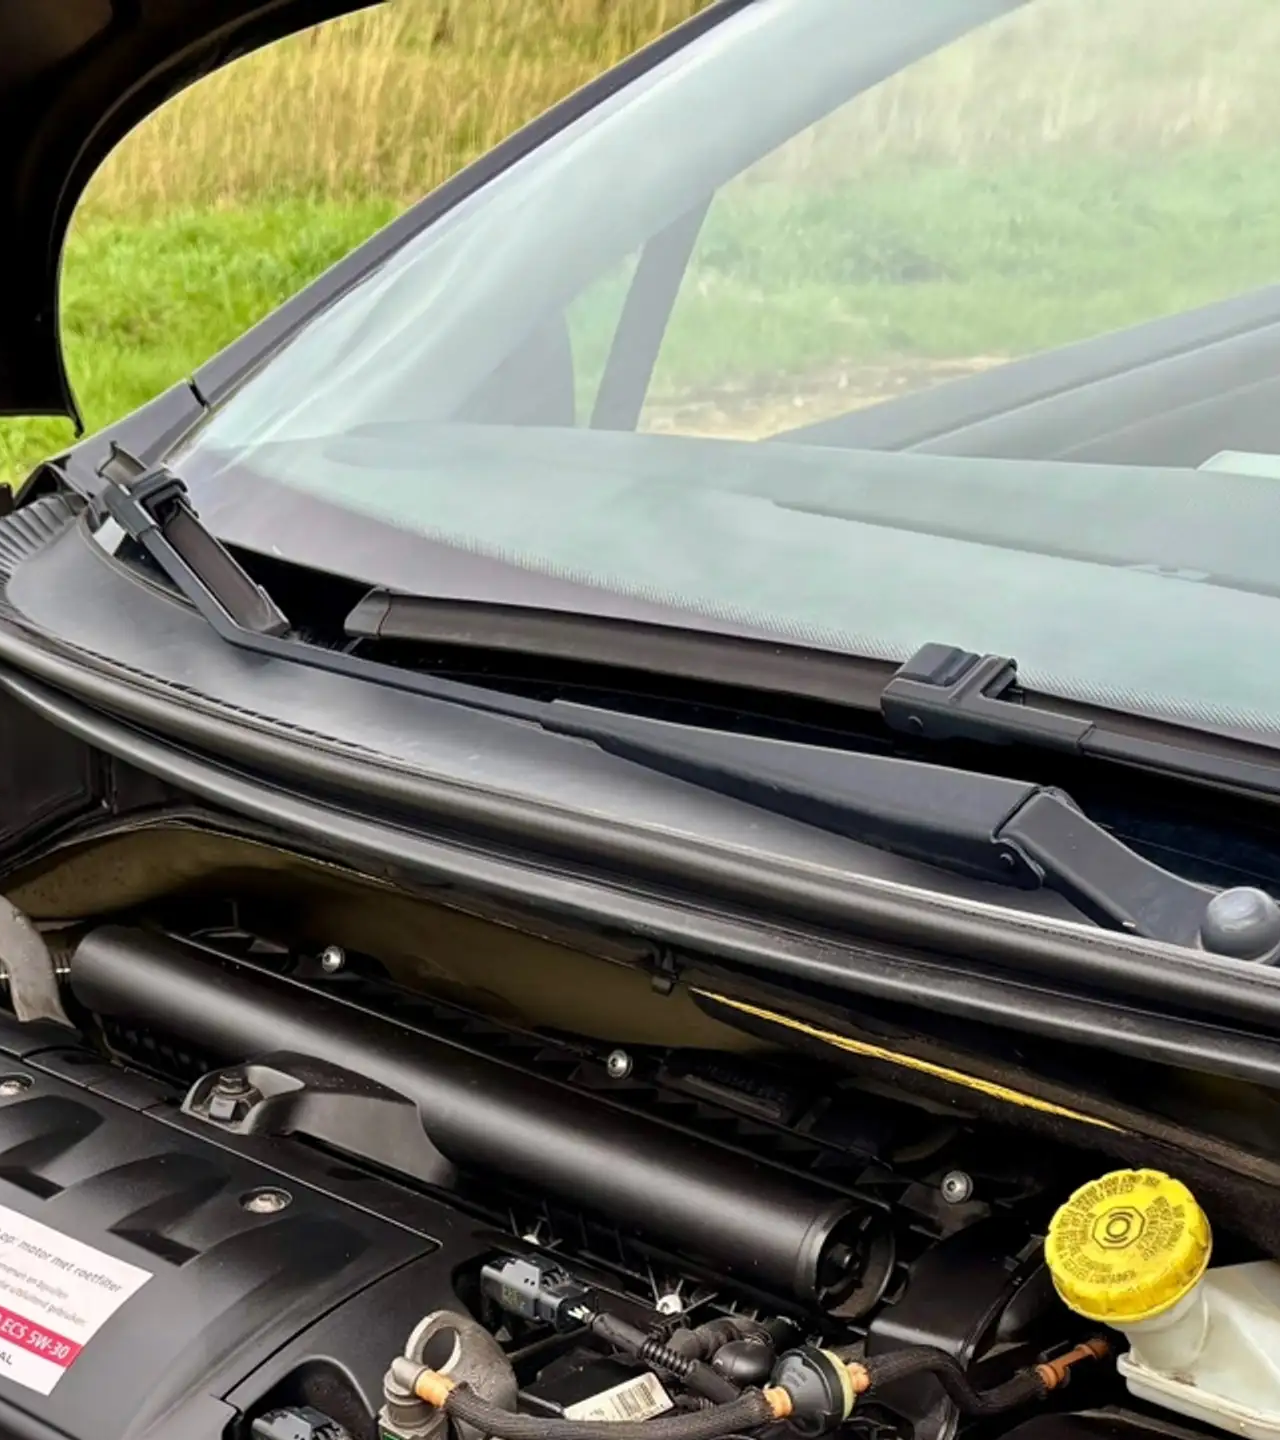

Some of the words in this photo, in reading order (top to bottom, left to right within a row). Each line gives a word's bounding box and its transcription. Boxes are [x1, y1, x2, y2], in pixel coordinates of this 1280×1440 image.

[18, 1240, 52, 1261] motor
[50, 1256, 75, 1273] met
[0, 1316, 29, 1340] ECS
[28, 1330, 71, 1361] 5W-30
